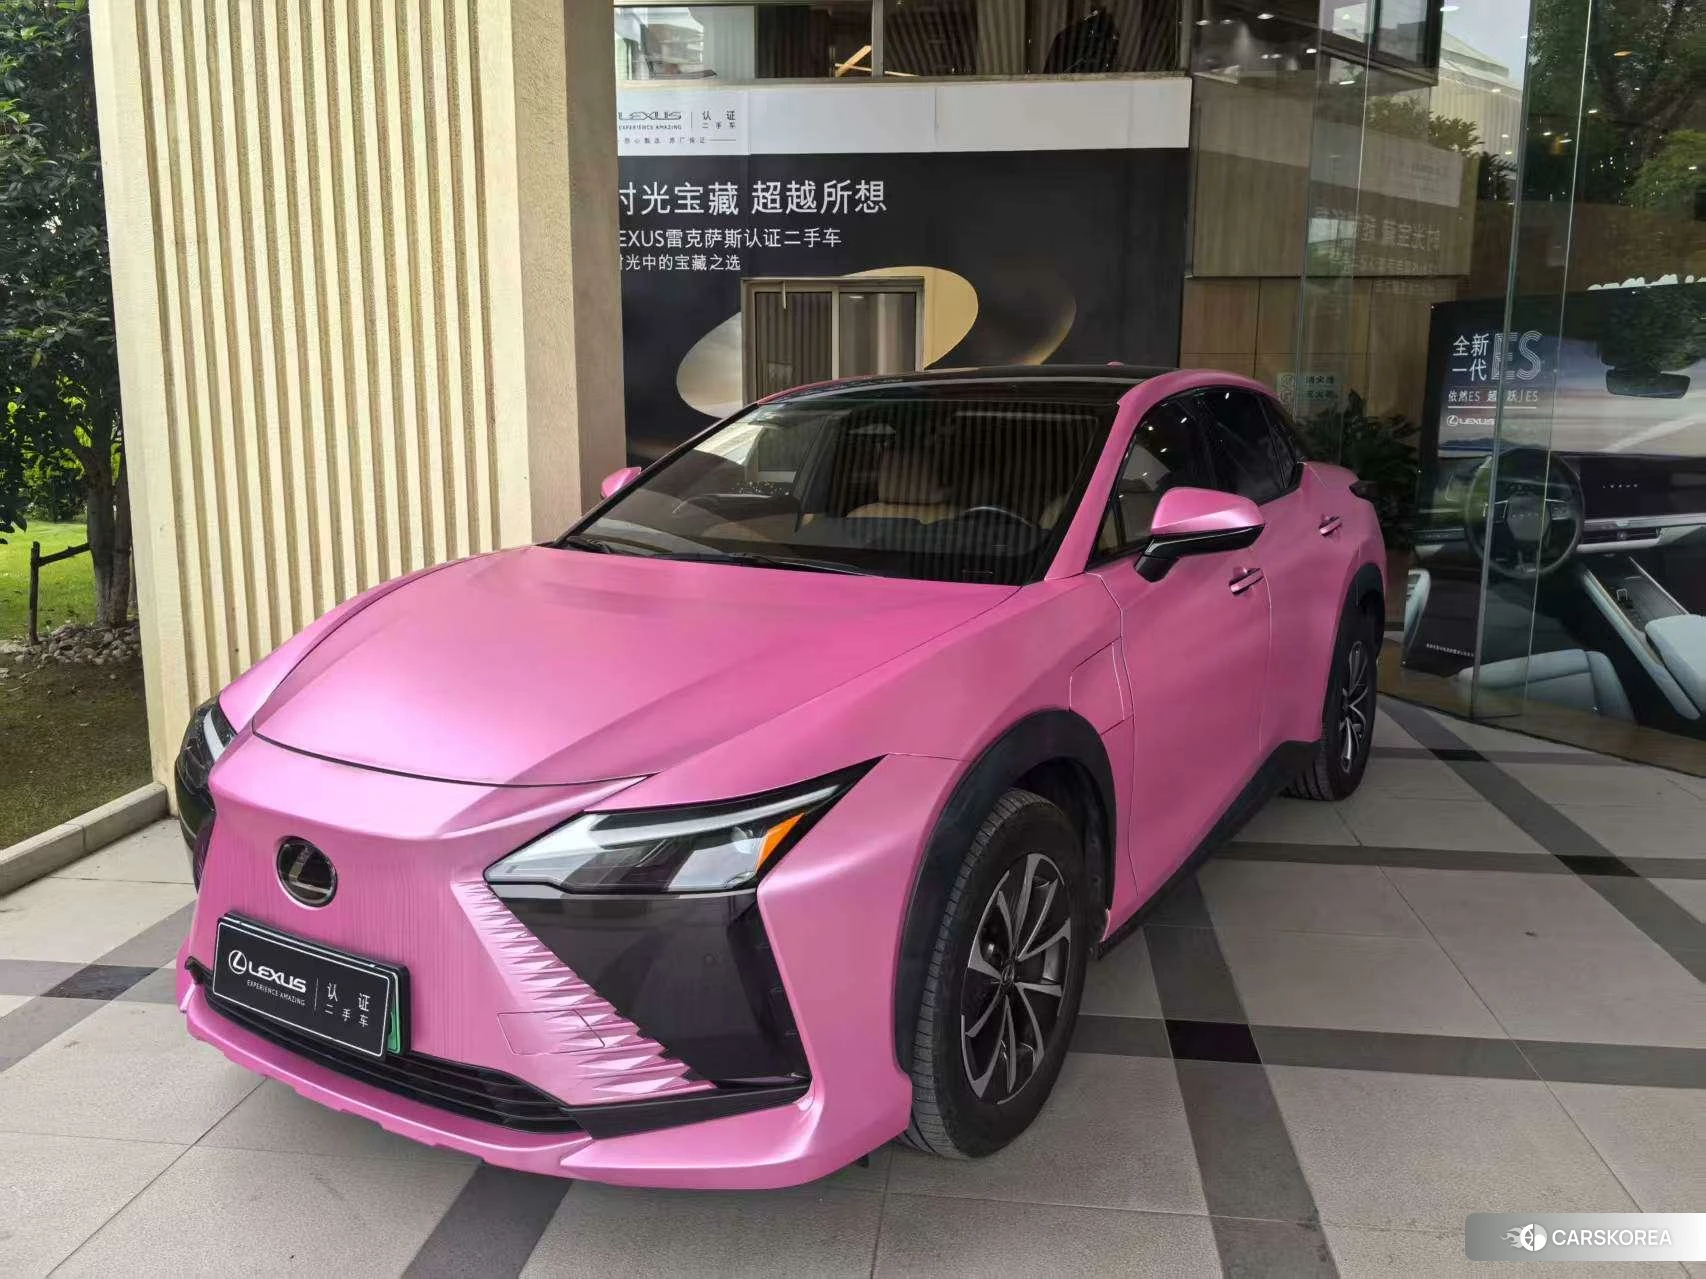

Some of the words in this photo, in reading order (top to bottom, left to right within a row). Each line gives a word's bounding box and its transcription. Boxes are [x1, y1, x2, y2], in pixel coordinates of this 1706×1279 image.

[618, 111, 682, 121] LEXUS
[702, 110, 736, 121] 认证
[752, 180, 887, 216] 超越所想
[1453, 333, 1489, 356] 全新
[1491, 331, 1542, 381] ES
[1452, 359, 1487, 381] 一代
[248, 960, 307, 993] LEXUS
[247, 979, 279, 997] EXPERIENCE
[280, 992, 306, 1006] AMAZING
[327, 982, 371, 1012] 认证
[325, 1003, 369, 1028] 二手车
